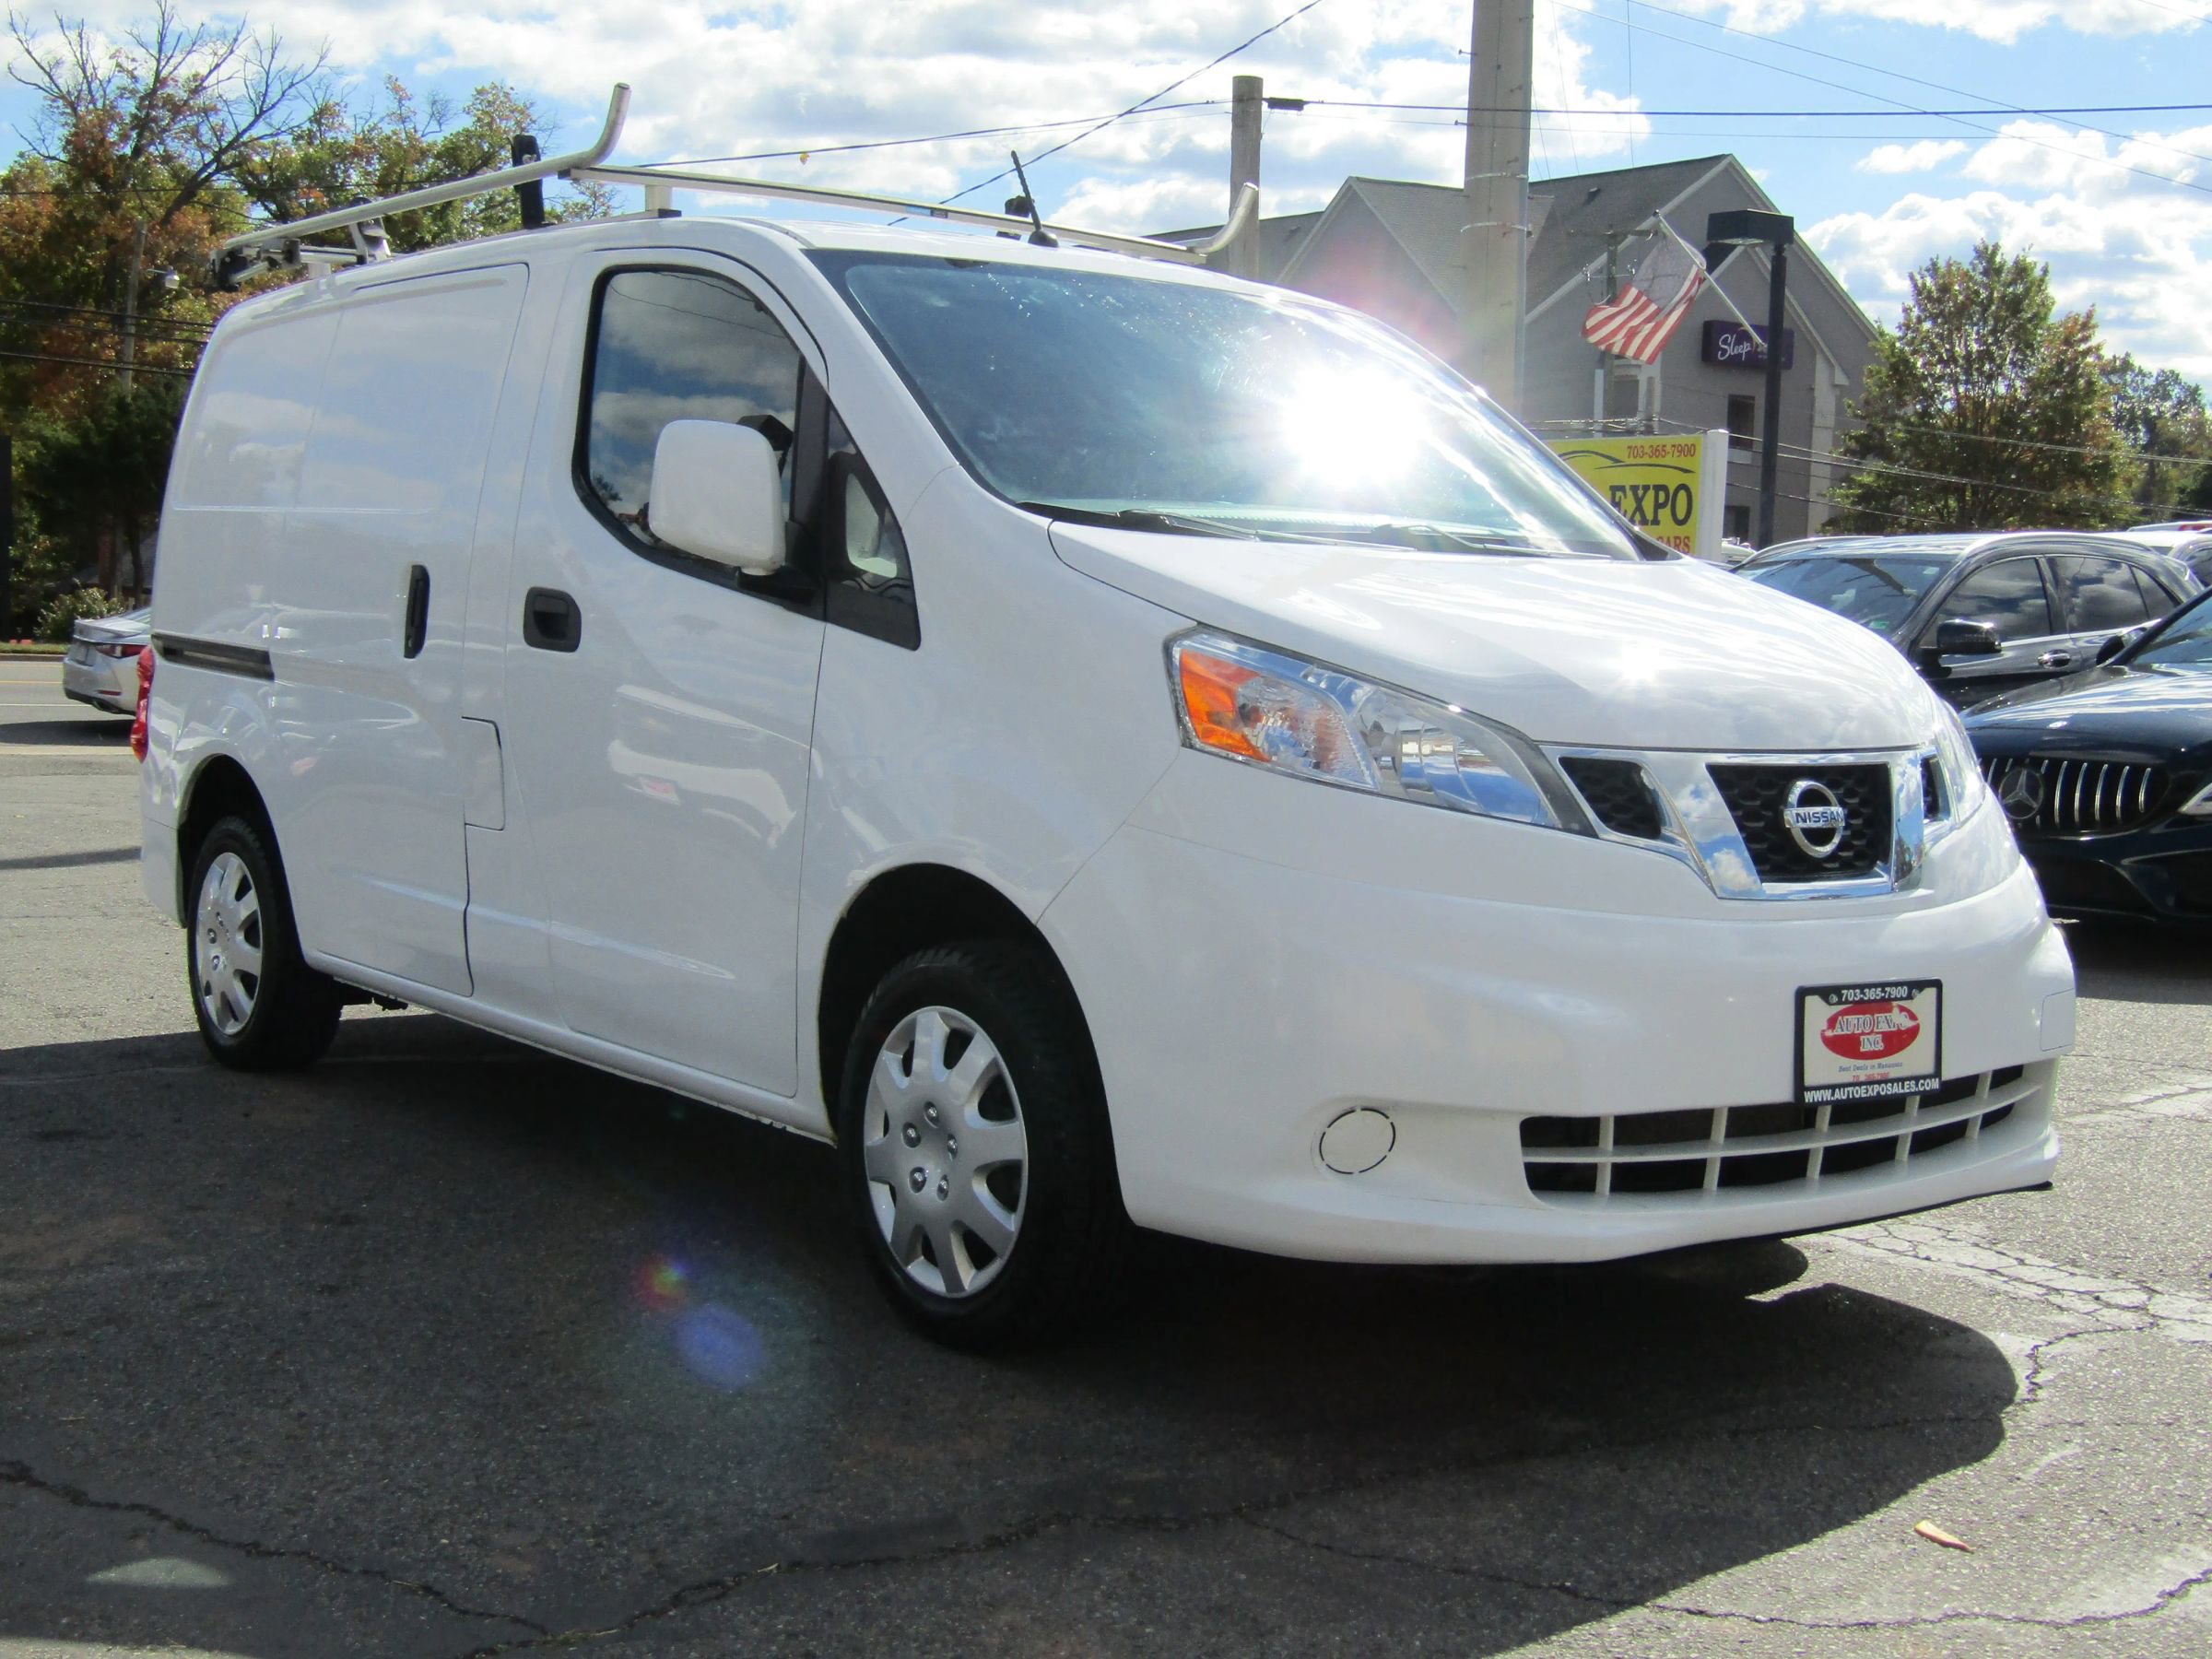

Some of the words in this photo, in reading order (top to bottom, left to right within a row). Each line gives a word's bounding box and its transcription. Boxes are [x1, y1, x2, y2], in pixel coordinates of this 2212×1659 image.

[1718, 334, 1752, 361] Sleep
[1627, 443, 1696, 459] 703-365-7900
[1608, 483, 1694, 526] EXPO
[1794, 811, 1843, 824] NISSAN
[1841, 986, 1908, 1002] 703-365-7900
[1834, 1015, 1873, 1033] AUTO
[1862, 1036, 1883, 1050] INC.
[1805, 1078, 1939, 1103] WWW.AUTOEXPOSALES.COM
